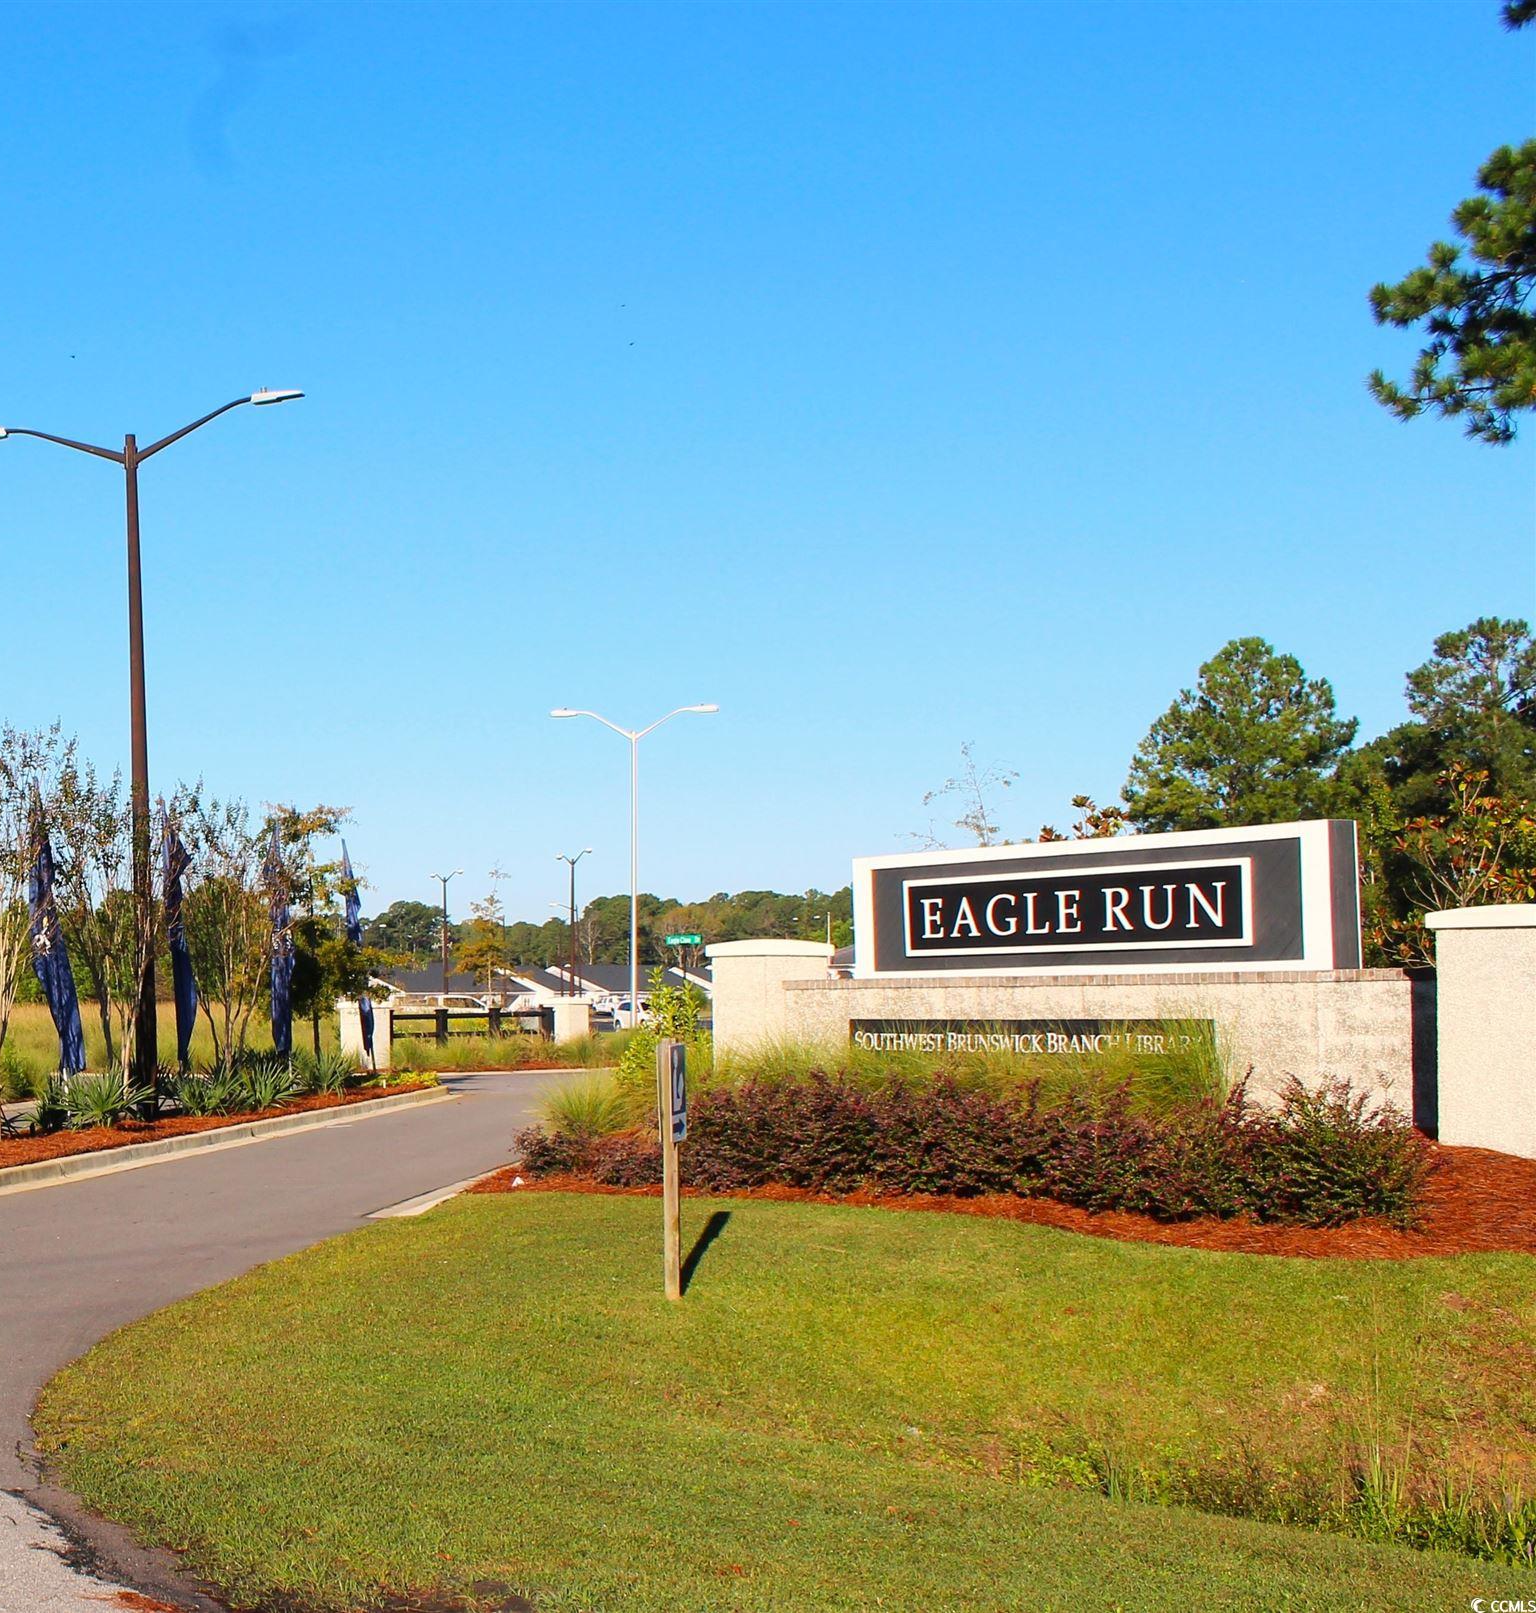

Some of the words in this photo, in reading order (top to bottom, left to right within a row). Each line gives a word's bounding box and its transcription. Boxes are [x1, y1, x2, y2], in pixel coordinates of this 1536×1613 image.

[920, 889, 1083, 940] EAGLE
[1101, 881, 1227, 932] RUN
[854, 1030, 944, 1052] SOUTHWEST
[947, 1032, 1044, 1053] BRUNSWICK
